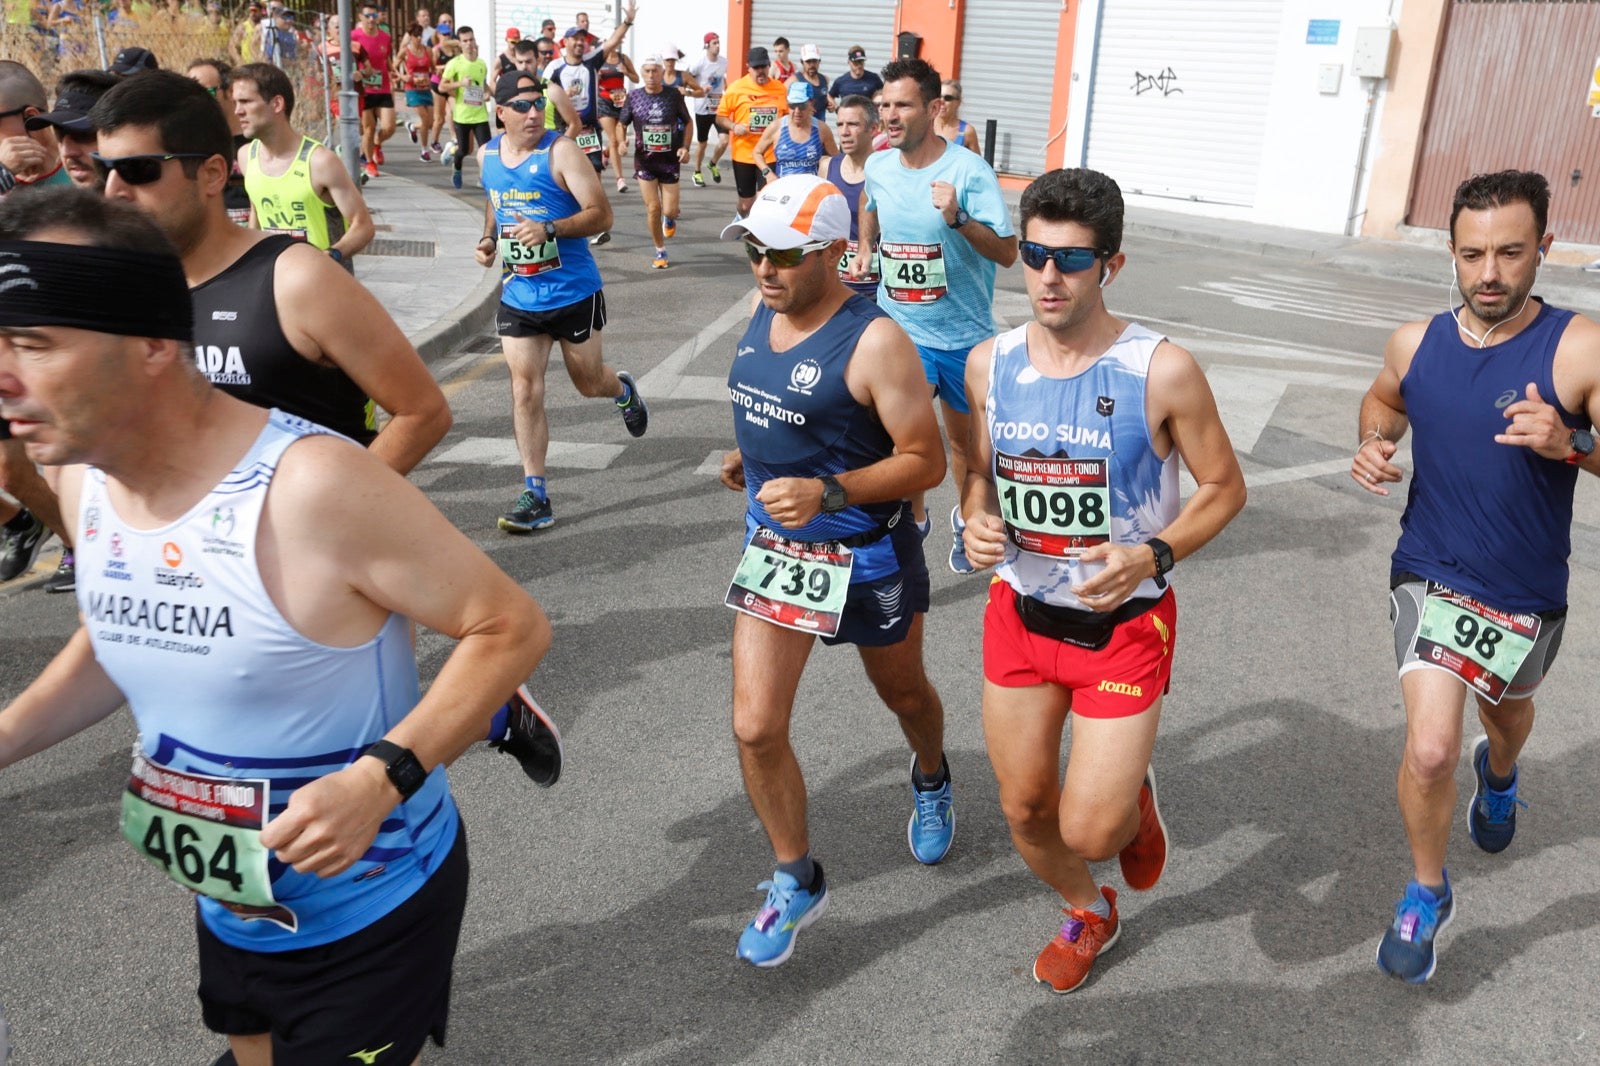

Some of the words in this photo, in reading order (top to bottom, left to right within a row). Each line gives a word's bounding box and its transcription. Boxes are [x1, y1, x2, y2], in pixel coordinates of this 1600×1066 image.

[754, 115, 773, 125] 979
[648, 134, 667, 144] 429
[510, 240, 547, 260] 537
[897, 263, 926, 284] 48
[796, 364, 817, 382] 30
[745, 411, 769, 428] Motril
[754, 402, 761, 412] a
[763, 402, 806, 425] PAZITO
[995, 422, 1049, 440] TODO
[1056, 424, 1112, 450] SUMA
[1013, 462, 1031, 473] GRAN
[1033, 464, 1062, 475] PREMIO
[1063, 464, 1073, 475] DE
[1074, 463, 1100, 475] FONDO
[1004, 485, 1105, 528] 1098
[760, 555, 831, 603] 739
[89, 590, 235, 638] MARACENA
[127, 634, 141, 645] DE
[144, 638, 211, 656] ATLETISMO
[1454, 614, 1503, 660] 98
[213, 784, 255, 808] FONDO
[143, 815, 243, 893] 464
